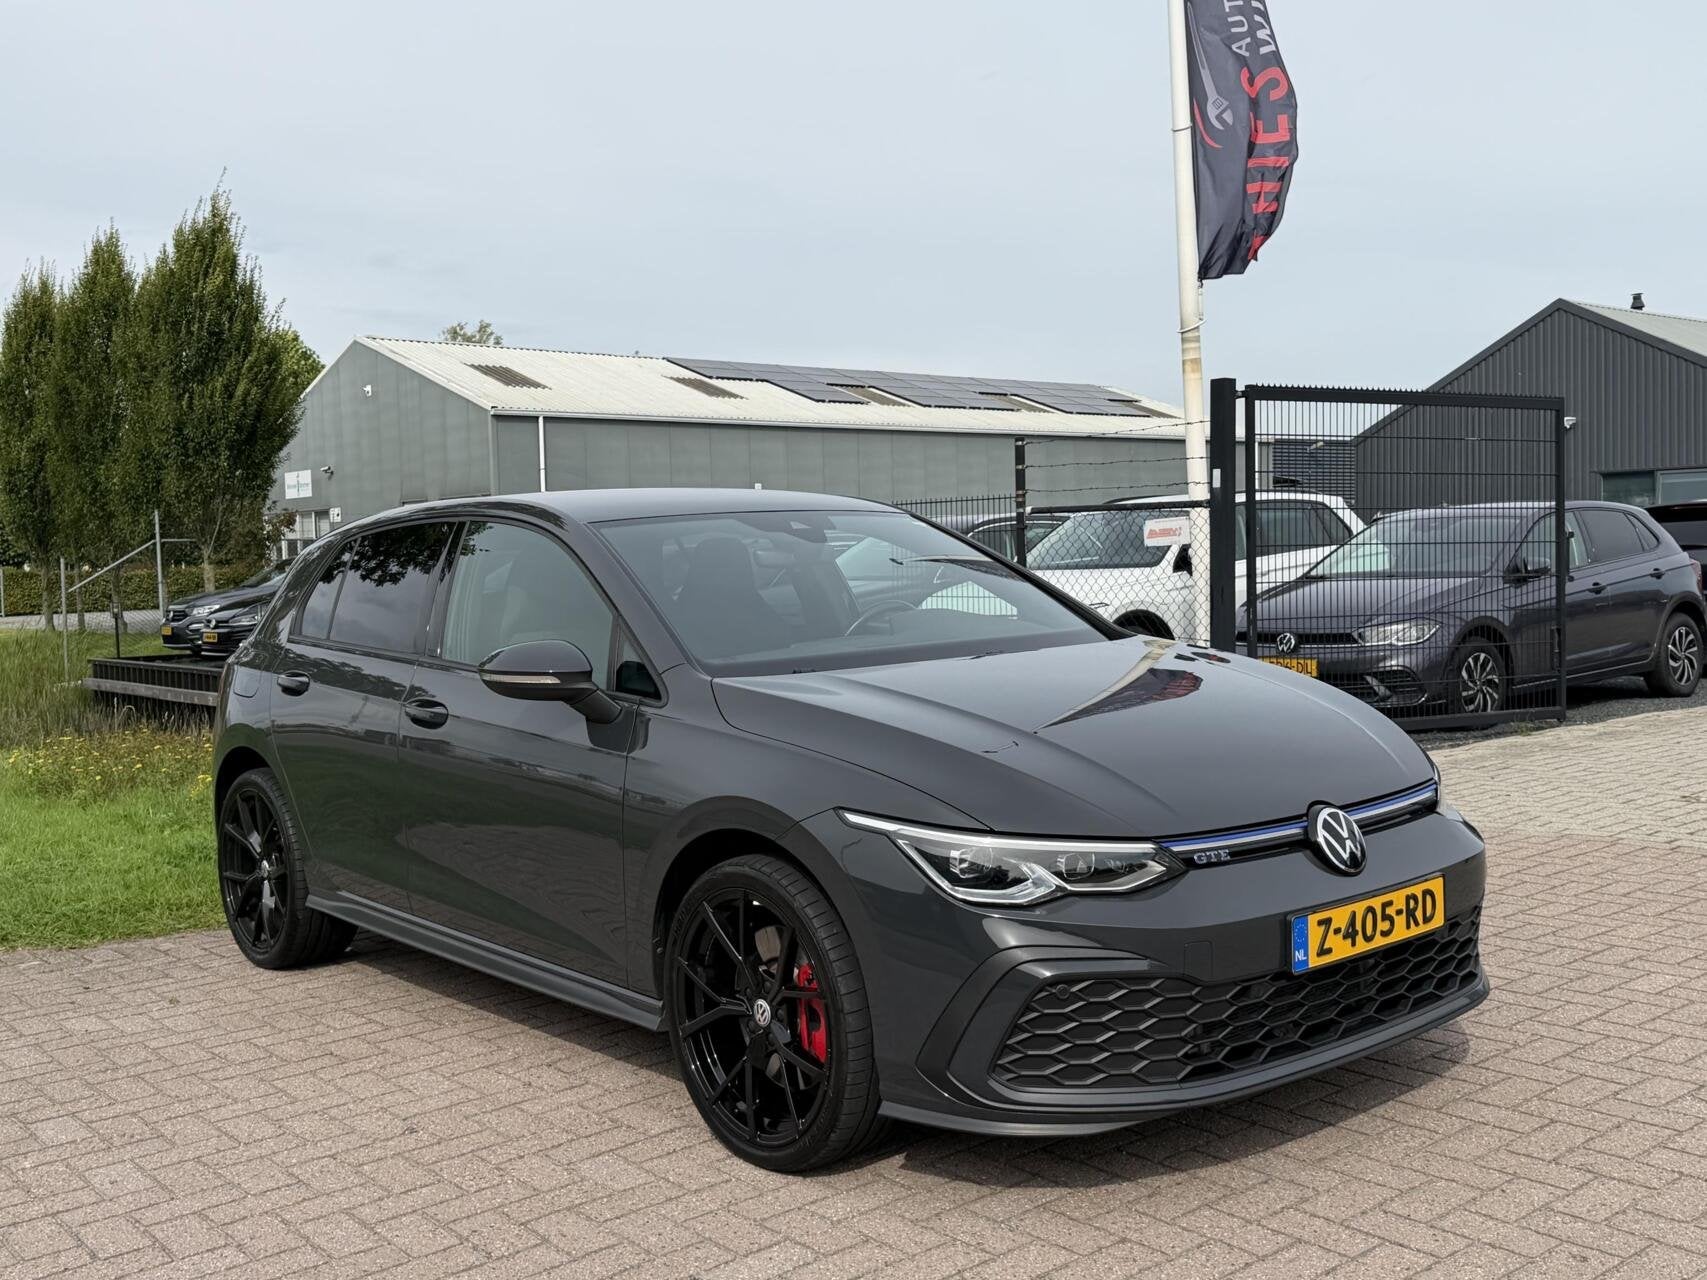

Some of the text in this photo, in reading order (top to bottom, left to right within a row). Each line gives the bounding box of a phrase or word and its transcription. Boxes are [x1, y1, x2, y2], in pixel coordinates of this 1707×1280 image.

[1193, 849, 1231, 865] GTE
[1295, 888, 1436, 962] NL Z-405-RD
